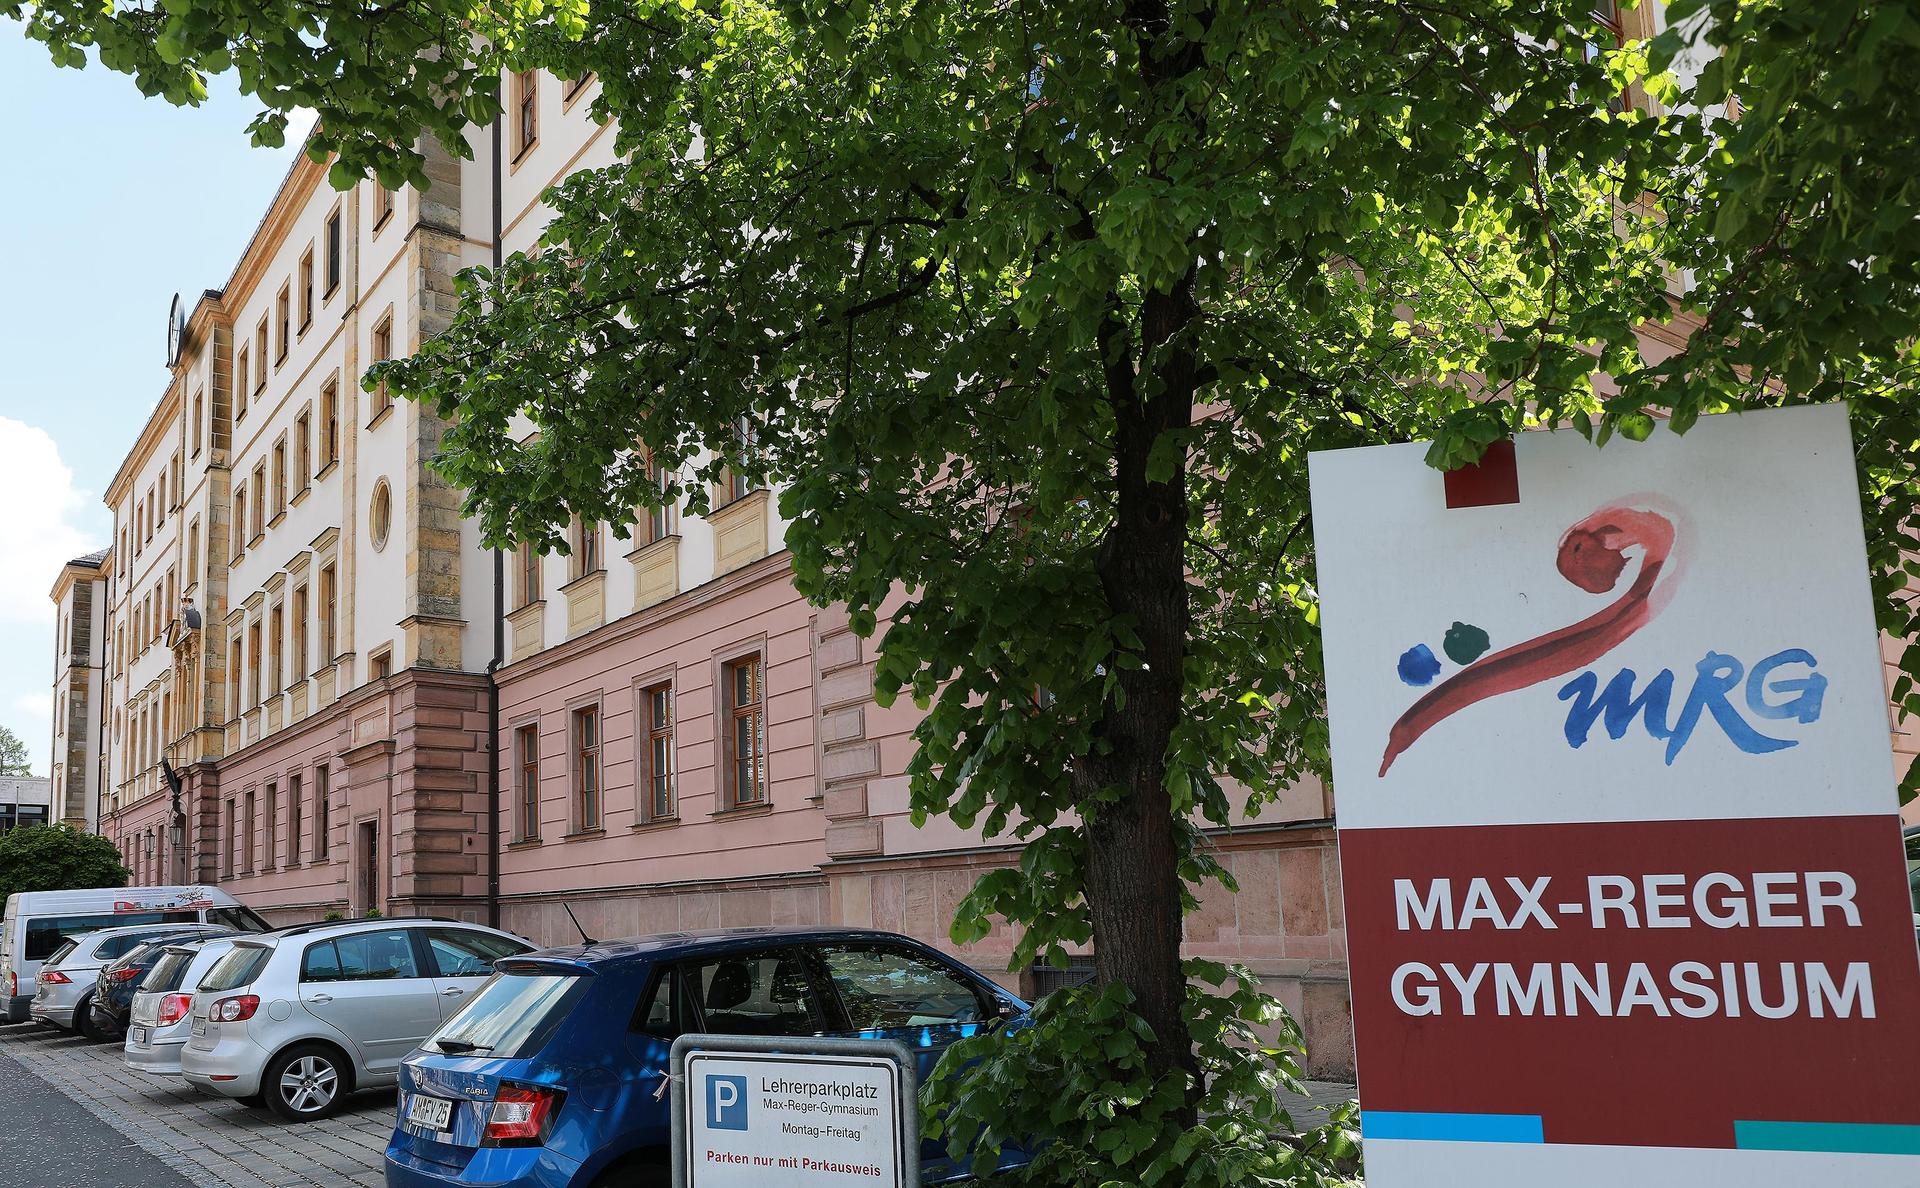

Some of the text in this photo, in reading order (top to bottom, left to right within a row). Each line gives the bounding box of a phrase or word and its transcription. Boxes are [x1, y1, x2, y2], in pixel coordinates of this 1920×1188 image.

[1393, 871, 1863, 931] MAX-REGER
[1390, 961, 1876, 1019] GYMNASIUM
[465, 1087, 489, 1095] FABIA
[762, 1076, 878, 1100] Lehrerparkplatz
[436, 1103, 449, 1124] 25
[715, 1080, 738, 1123] P
[763, 1099, 879, 1116] Max-Reger-Gymnasium
[707, 1150, 881, 1177] Parken nur mit Parkausweis
